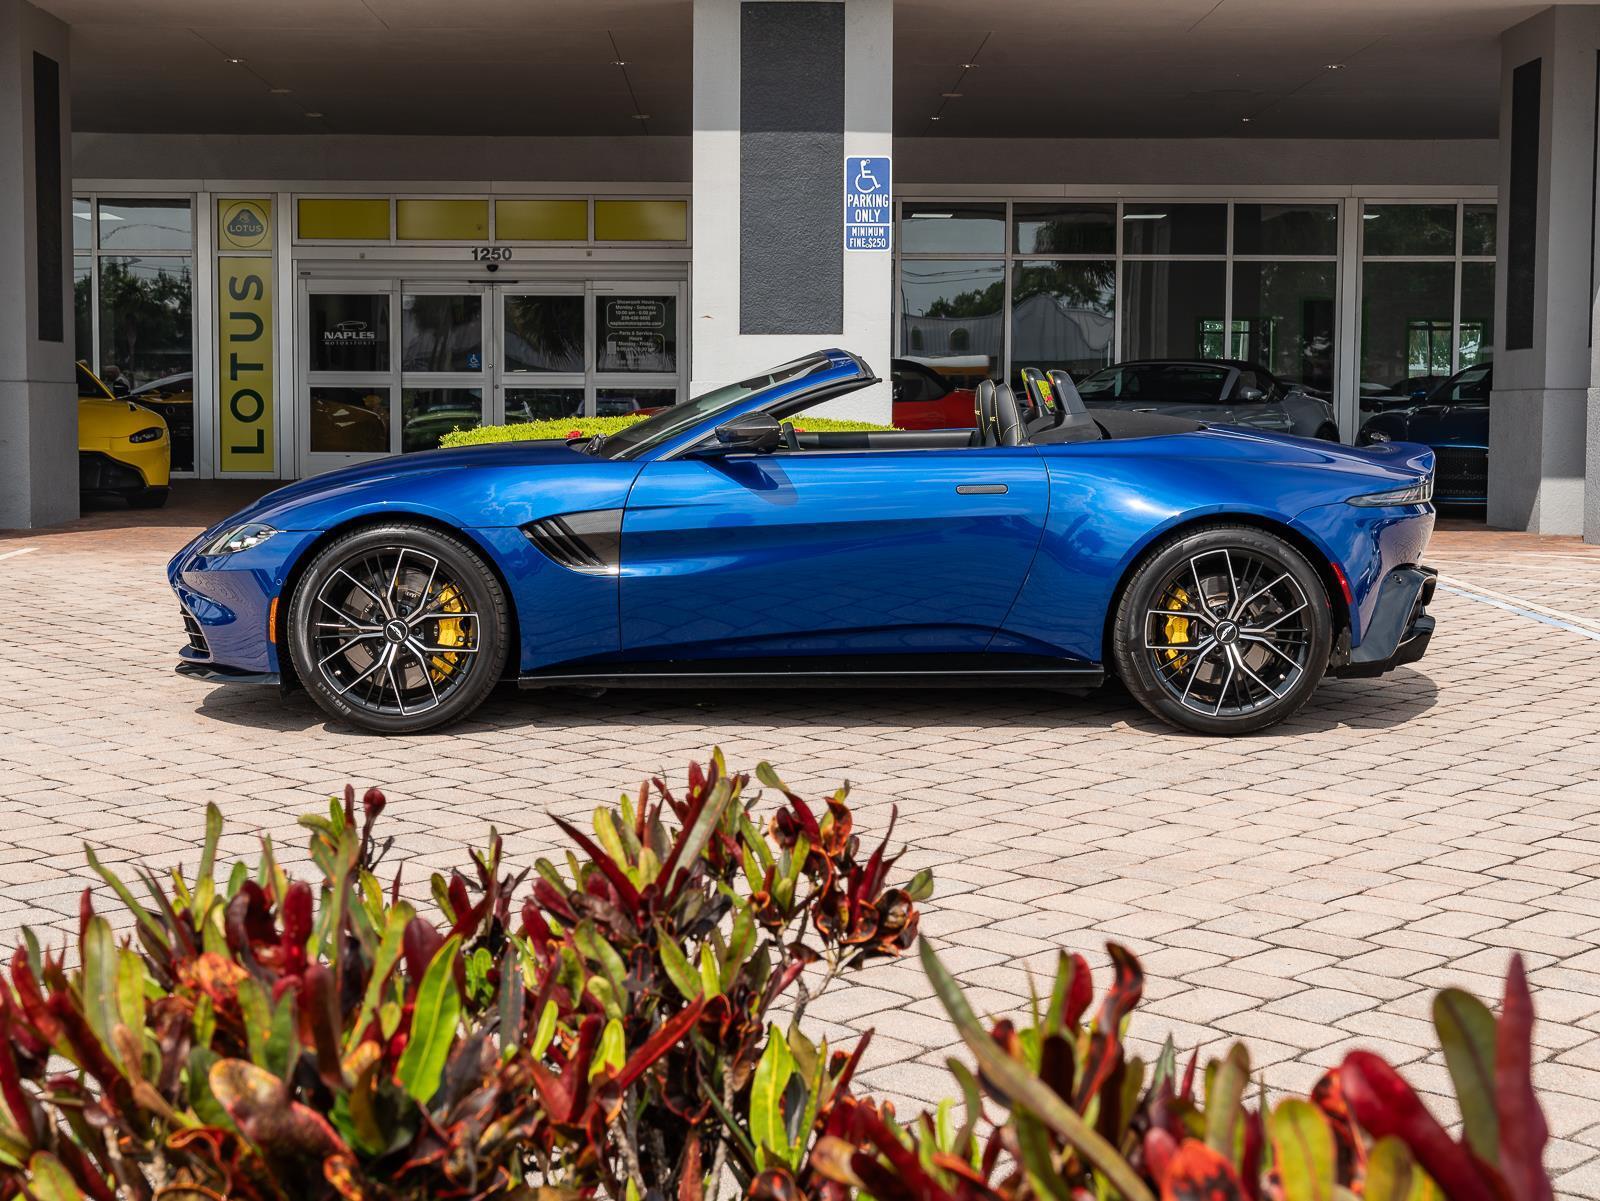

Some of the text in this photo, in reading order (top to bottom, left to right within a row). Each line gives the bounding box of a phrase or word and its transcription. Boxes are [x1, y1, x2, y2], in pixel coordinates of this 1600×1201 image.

[848, 194, 889, 208] PARKING
[855, 209, 881, 223] ONLY
[230, 224, 262, 233] LOTUS
[851, 227, 884, 236] MINIMUM
[849, 237, 886, 249] FINE $250
[471, 247, 513, 261] 1250
[324, 331, 375, 339] NAPLES
[229, 274, 265, 455] LOTUS
